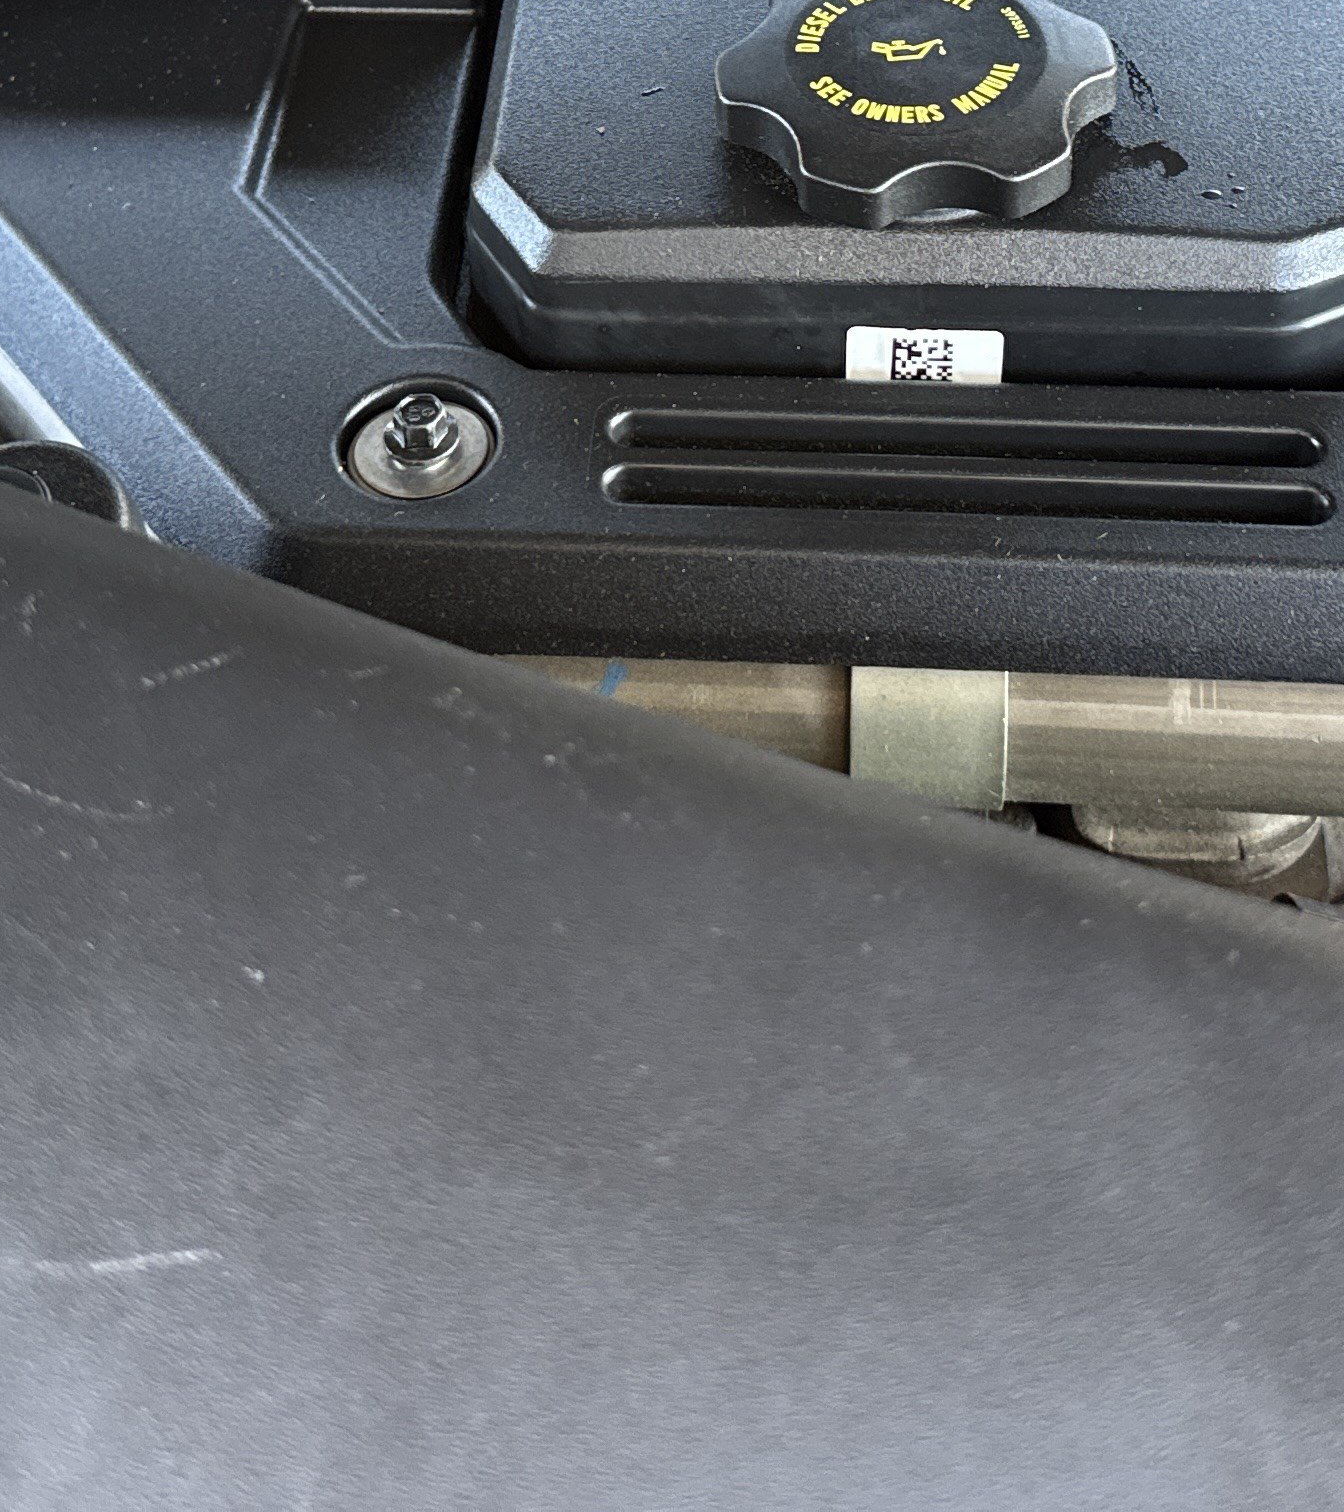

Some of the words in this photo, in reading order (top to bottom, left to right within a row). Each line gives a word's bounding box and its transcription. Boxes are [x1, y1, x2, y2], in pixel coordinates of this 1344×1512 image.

[794, 0, 849, 54] DIESEL
[808, 74, 854, 107] SEE
[850, 98, 946, 125] OWNERS
[951, 61, 1021, 116] MANUAL
